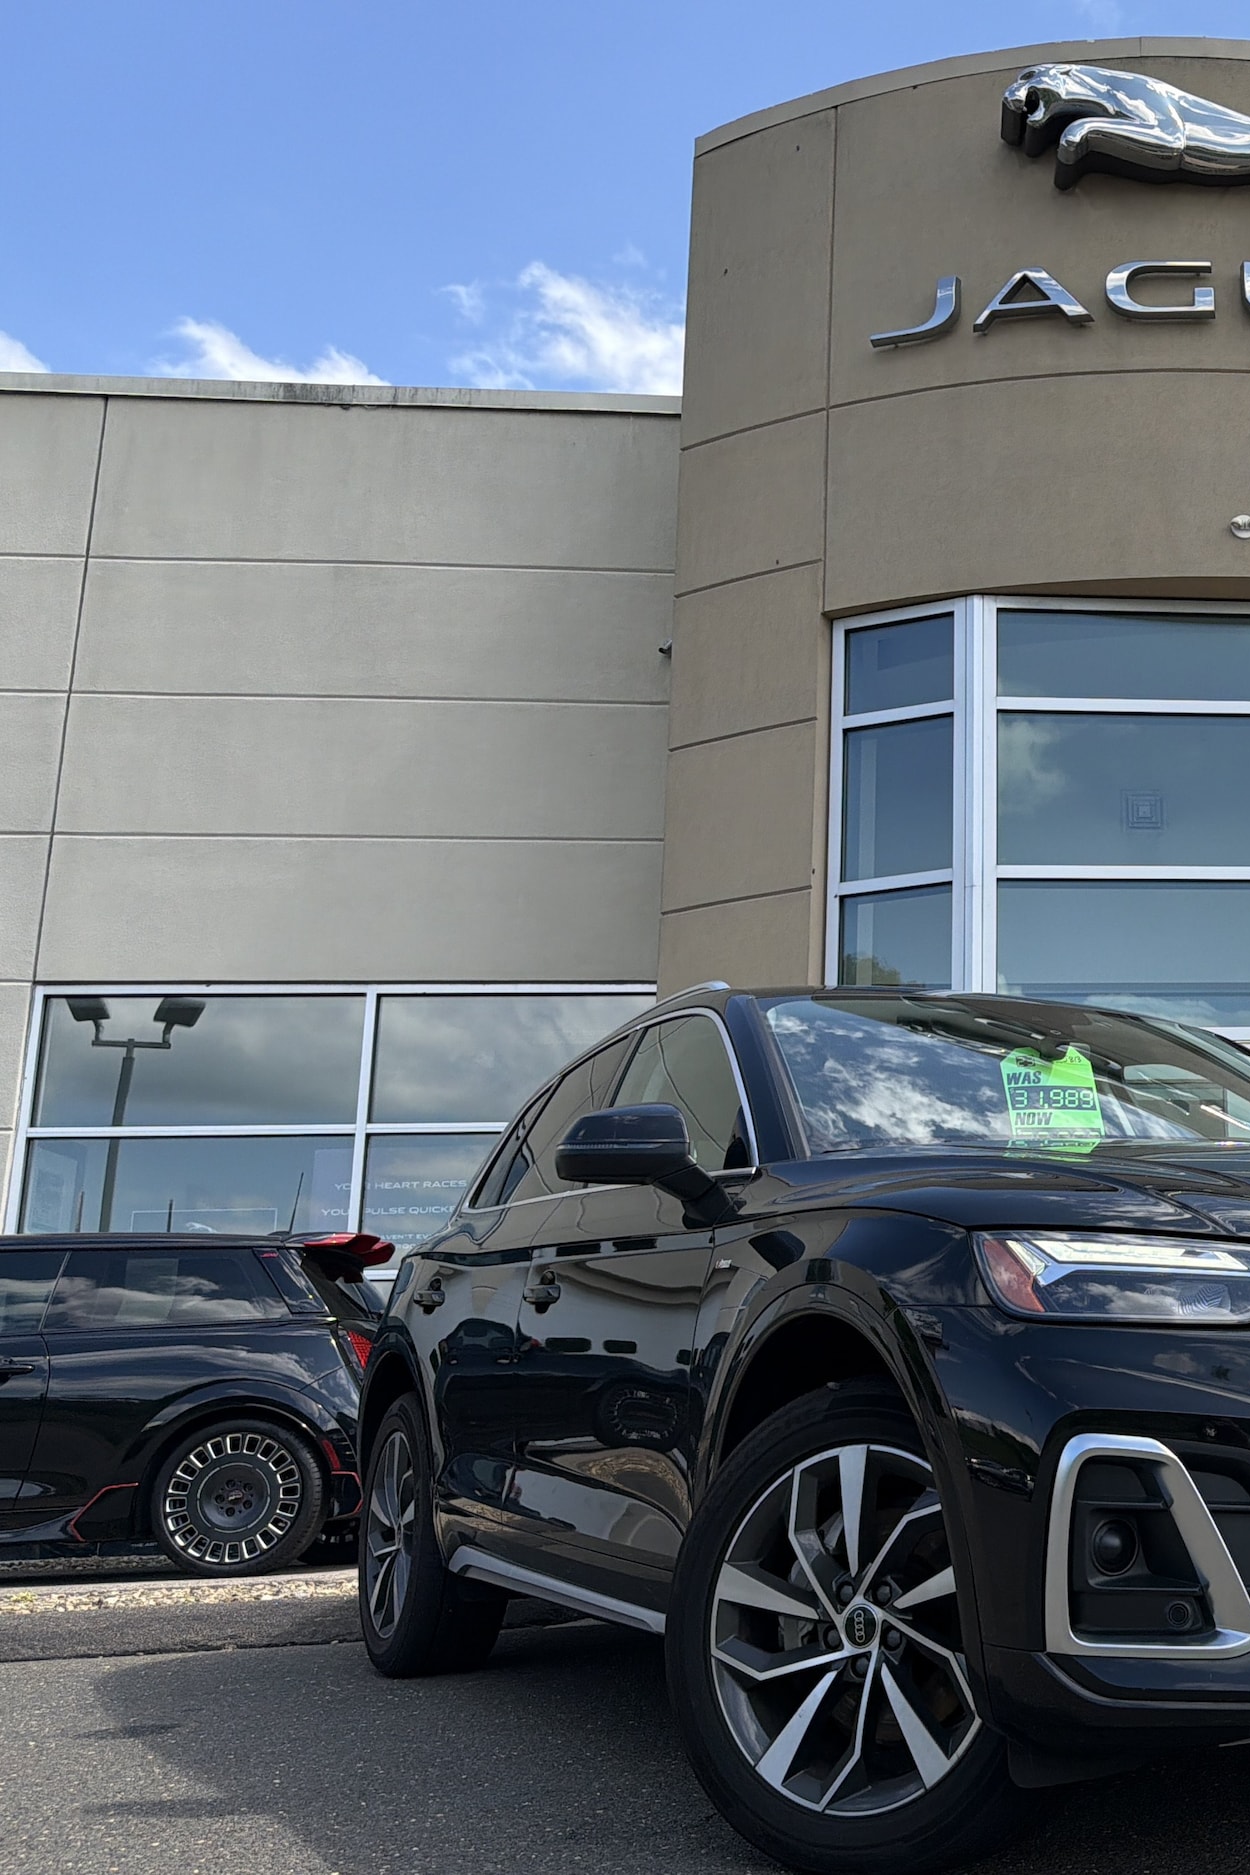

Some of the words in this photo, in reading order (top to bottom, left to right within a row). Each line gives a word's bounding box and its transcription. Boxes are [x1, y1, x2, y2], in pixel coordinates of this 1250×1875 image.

[1007, 1071, 1042, 1085] WAS
[1015, 1112, 1053, 1126] NOW
[375, 1181, 419, 1190] HEART
[423, 1180, 467, 1188] RACES
[366, 1207, 405, 1215] PULSE
